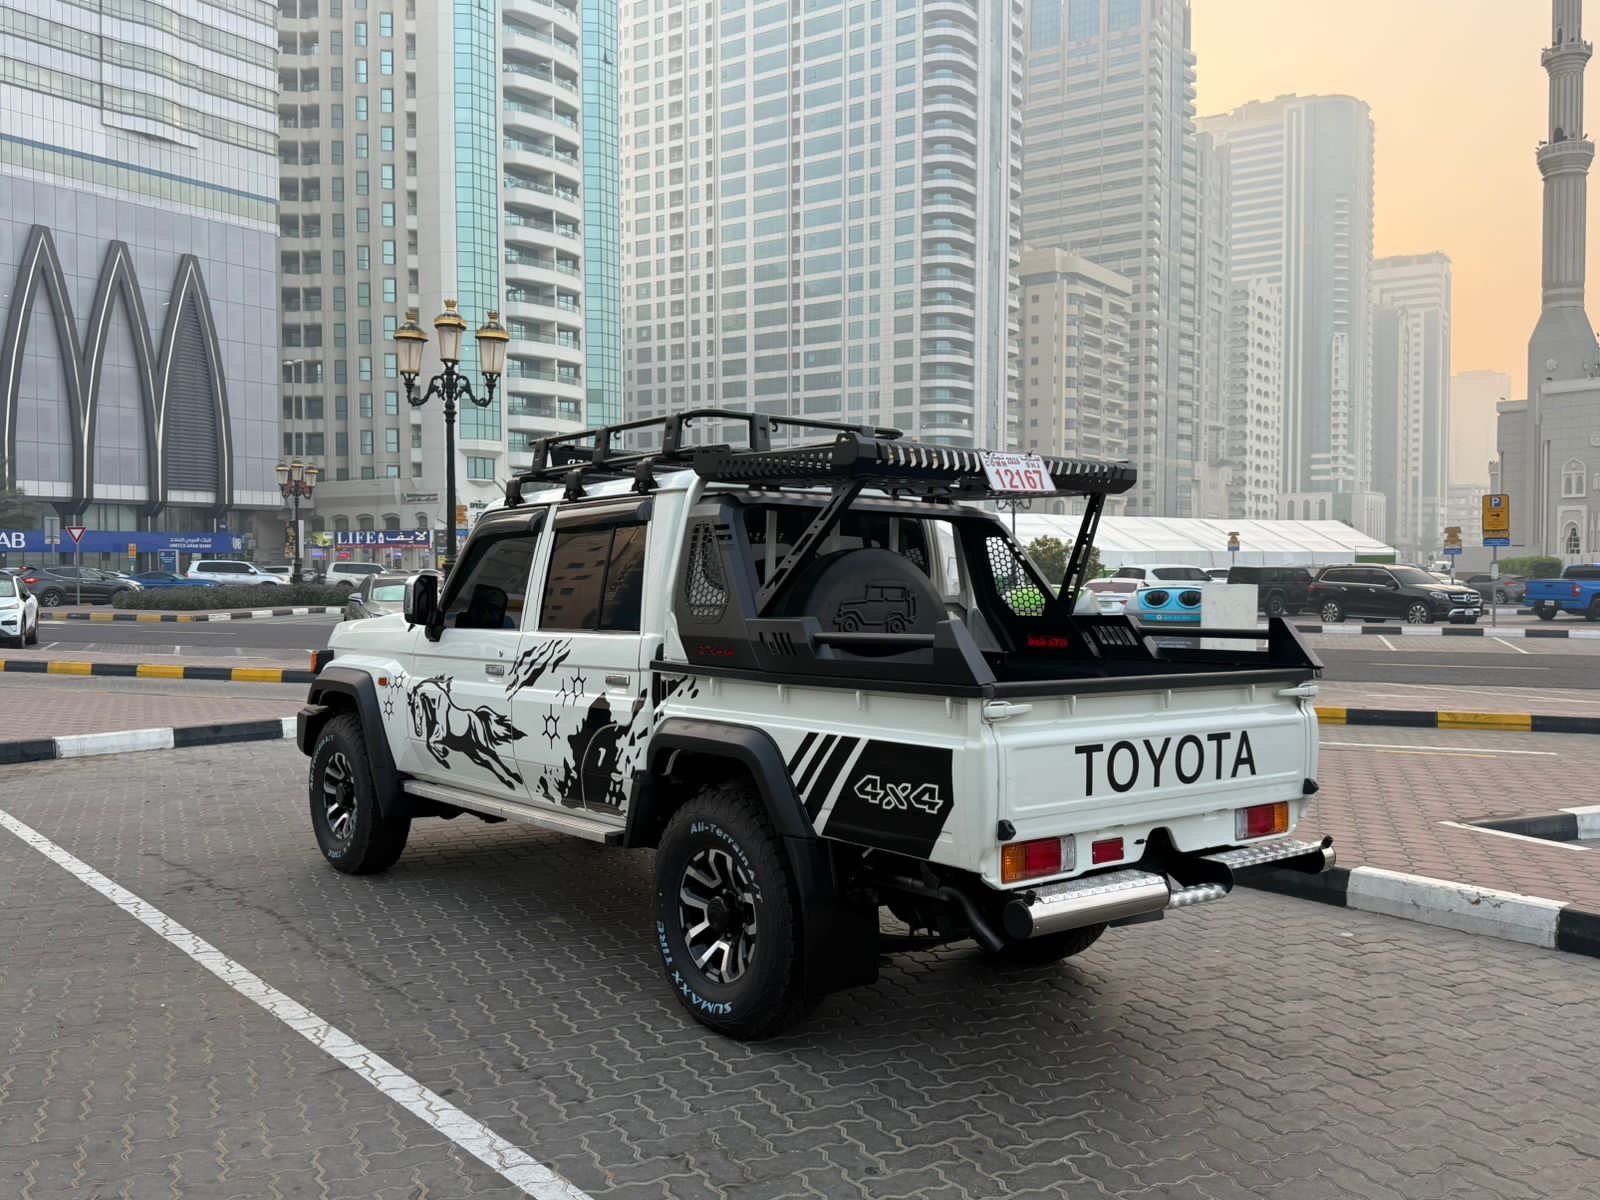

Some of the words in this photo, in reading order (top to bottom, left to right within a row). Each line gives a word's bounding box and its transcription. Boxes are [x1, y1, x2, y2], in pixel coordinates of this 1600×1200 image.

[995, 468, 1045, 490] 12167
[0, 531, 26, 549] AB
[337, 531, 376, 545] LIFE
[386, 530, 428, 544] لايف
[1075, 730, 1257, 797] TOYOTA
[688, 821, 750, 867] All-Terrain
[671, 969, 733, 1015] SUMAXX
